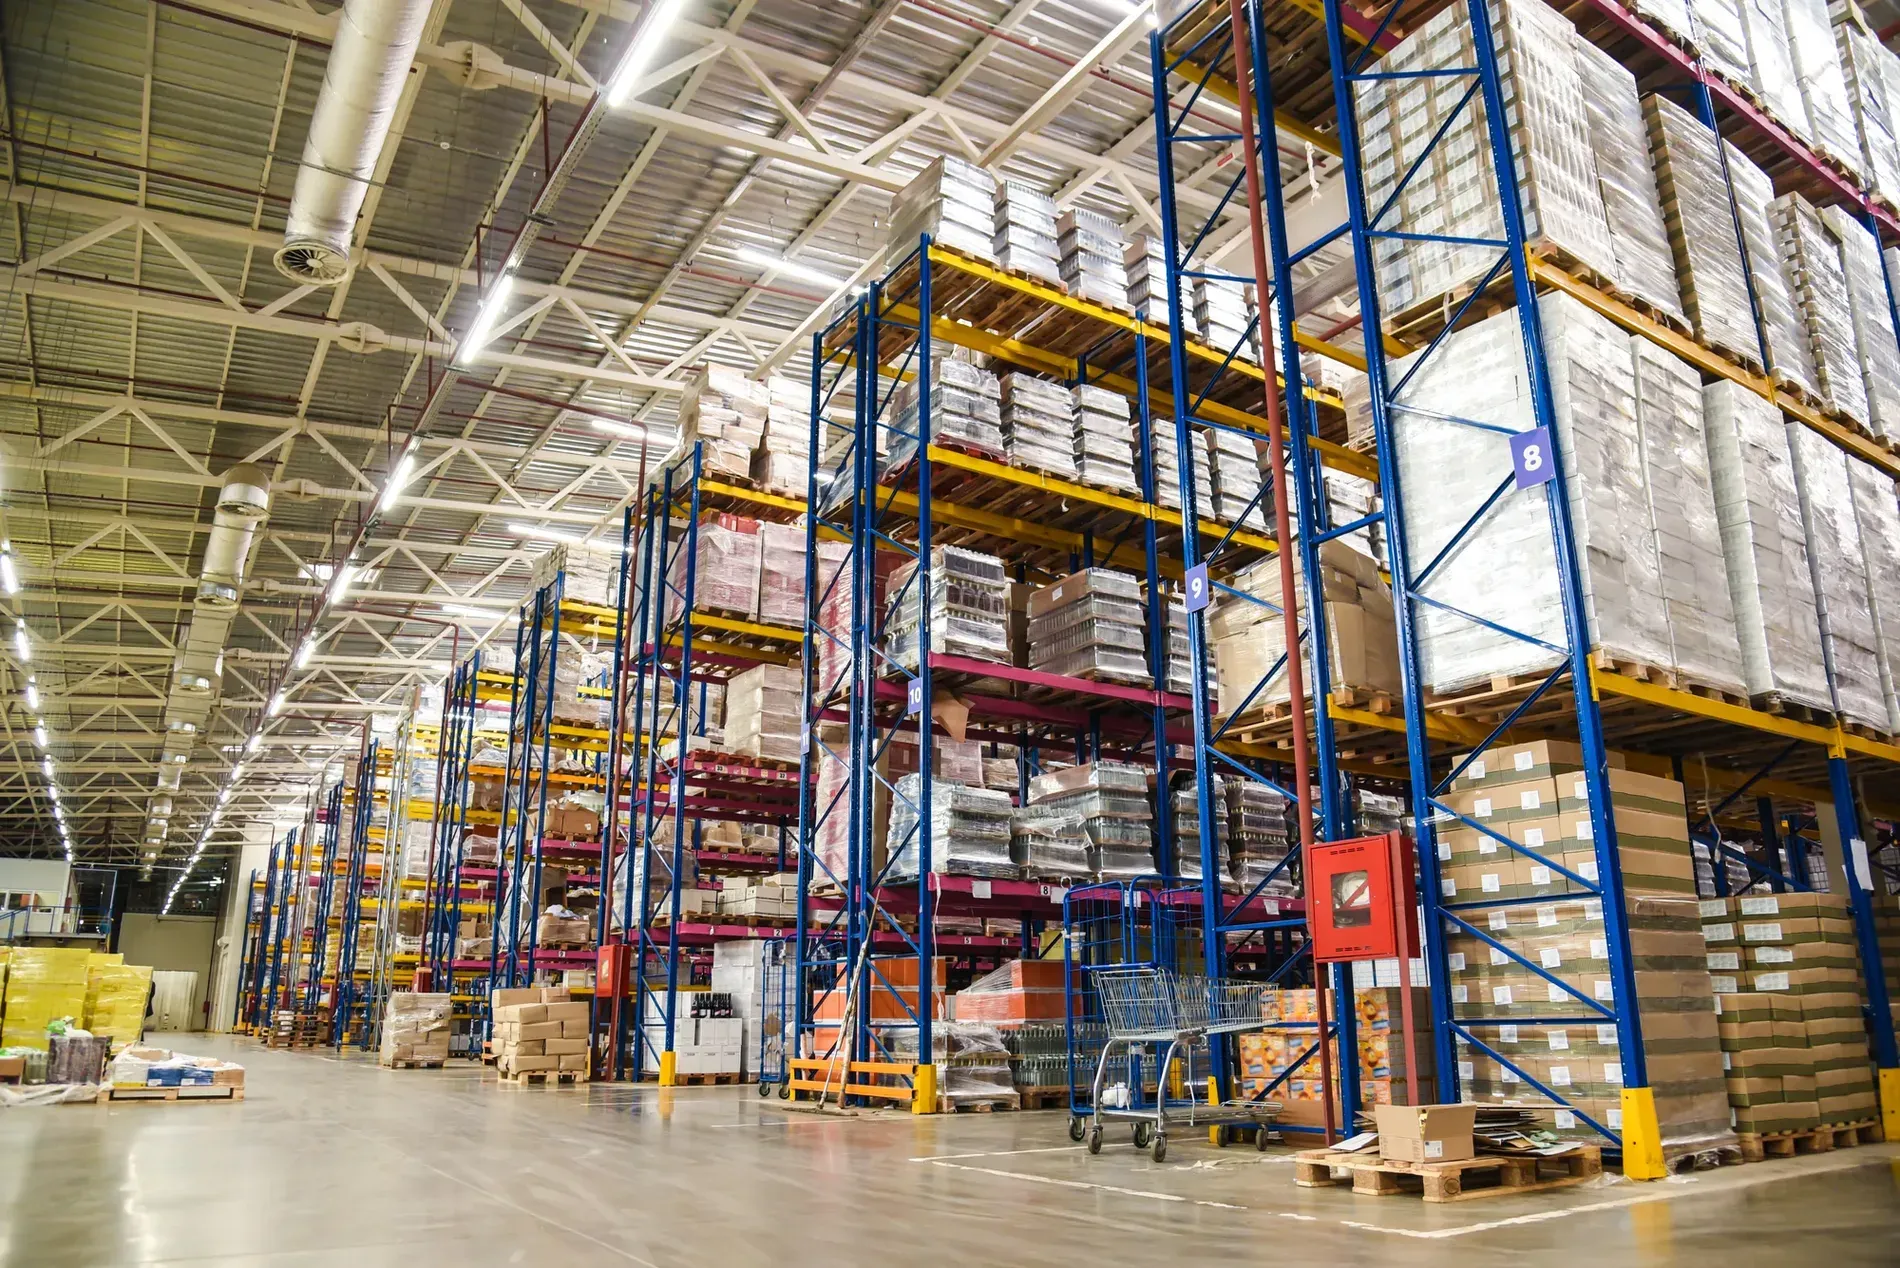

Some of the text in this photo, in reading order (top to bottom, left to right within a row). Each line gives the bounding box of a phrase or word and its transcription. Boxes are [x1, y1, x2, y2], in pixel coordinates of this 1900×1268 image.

[1523, 444, 1542, 472] 8
[1191, 577, 1202, 600] 9
[909, 686, 921, 705] 10
[1043, 885, 1049, 895] 8
